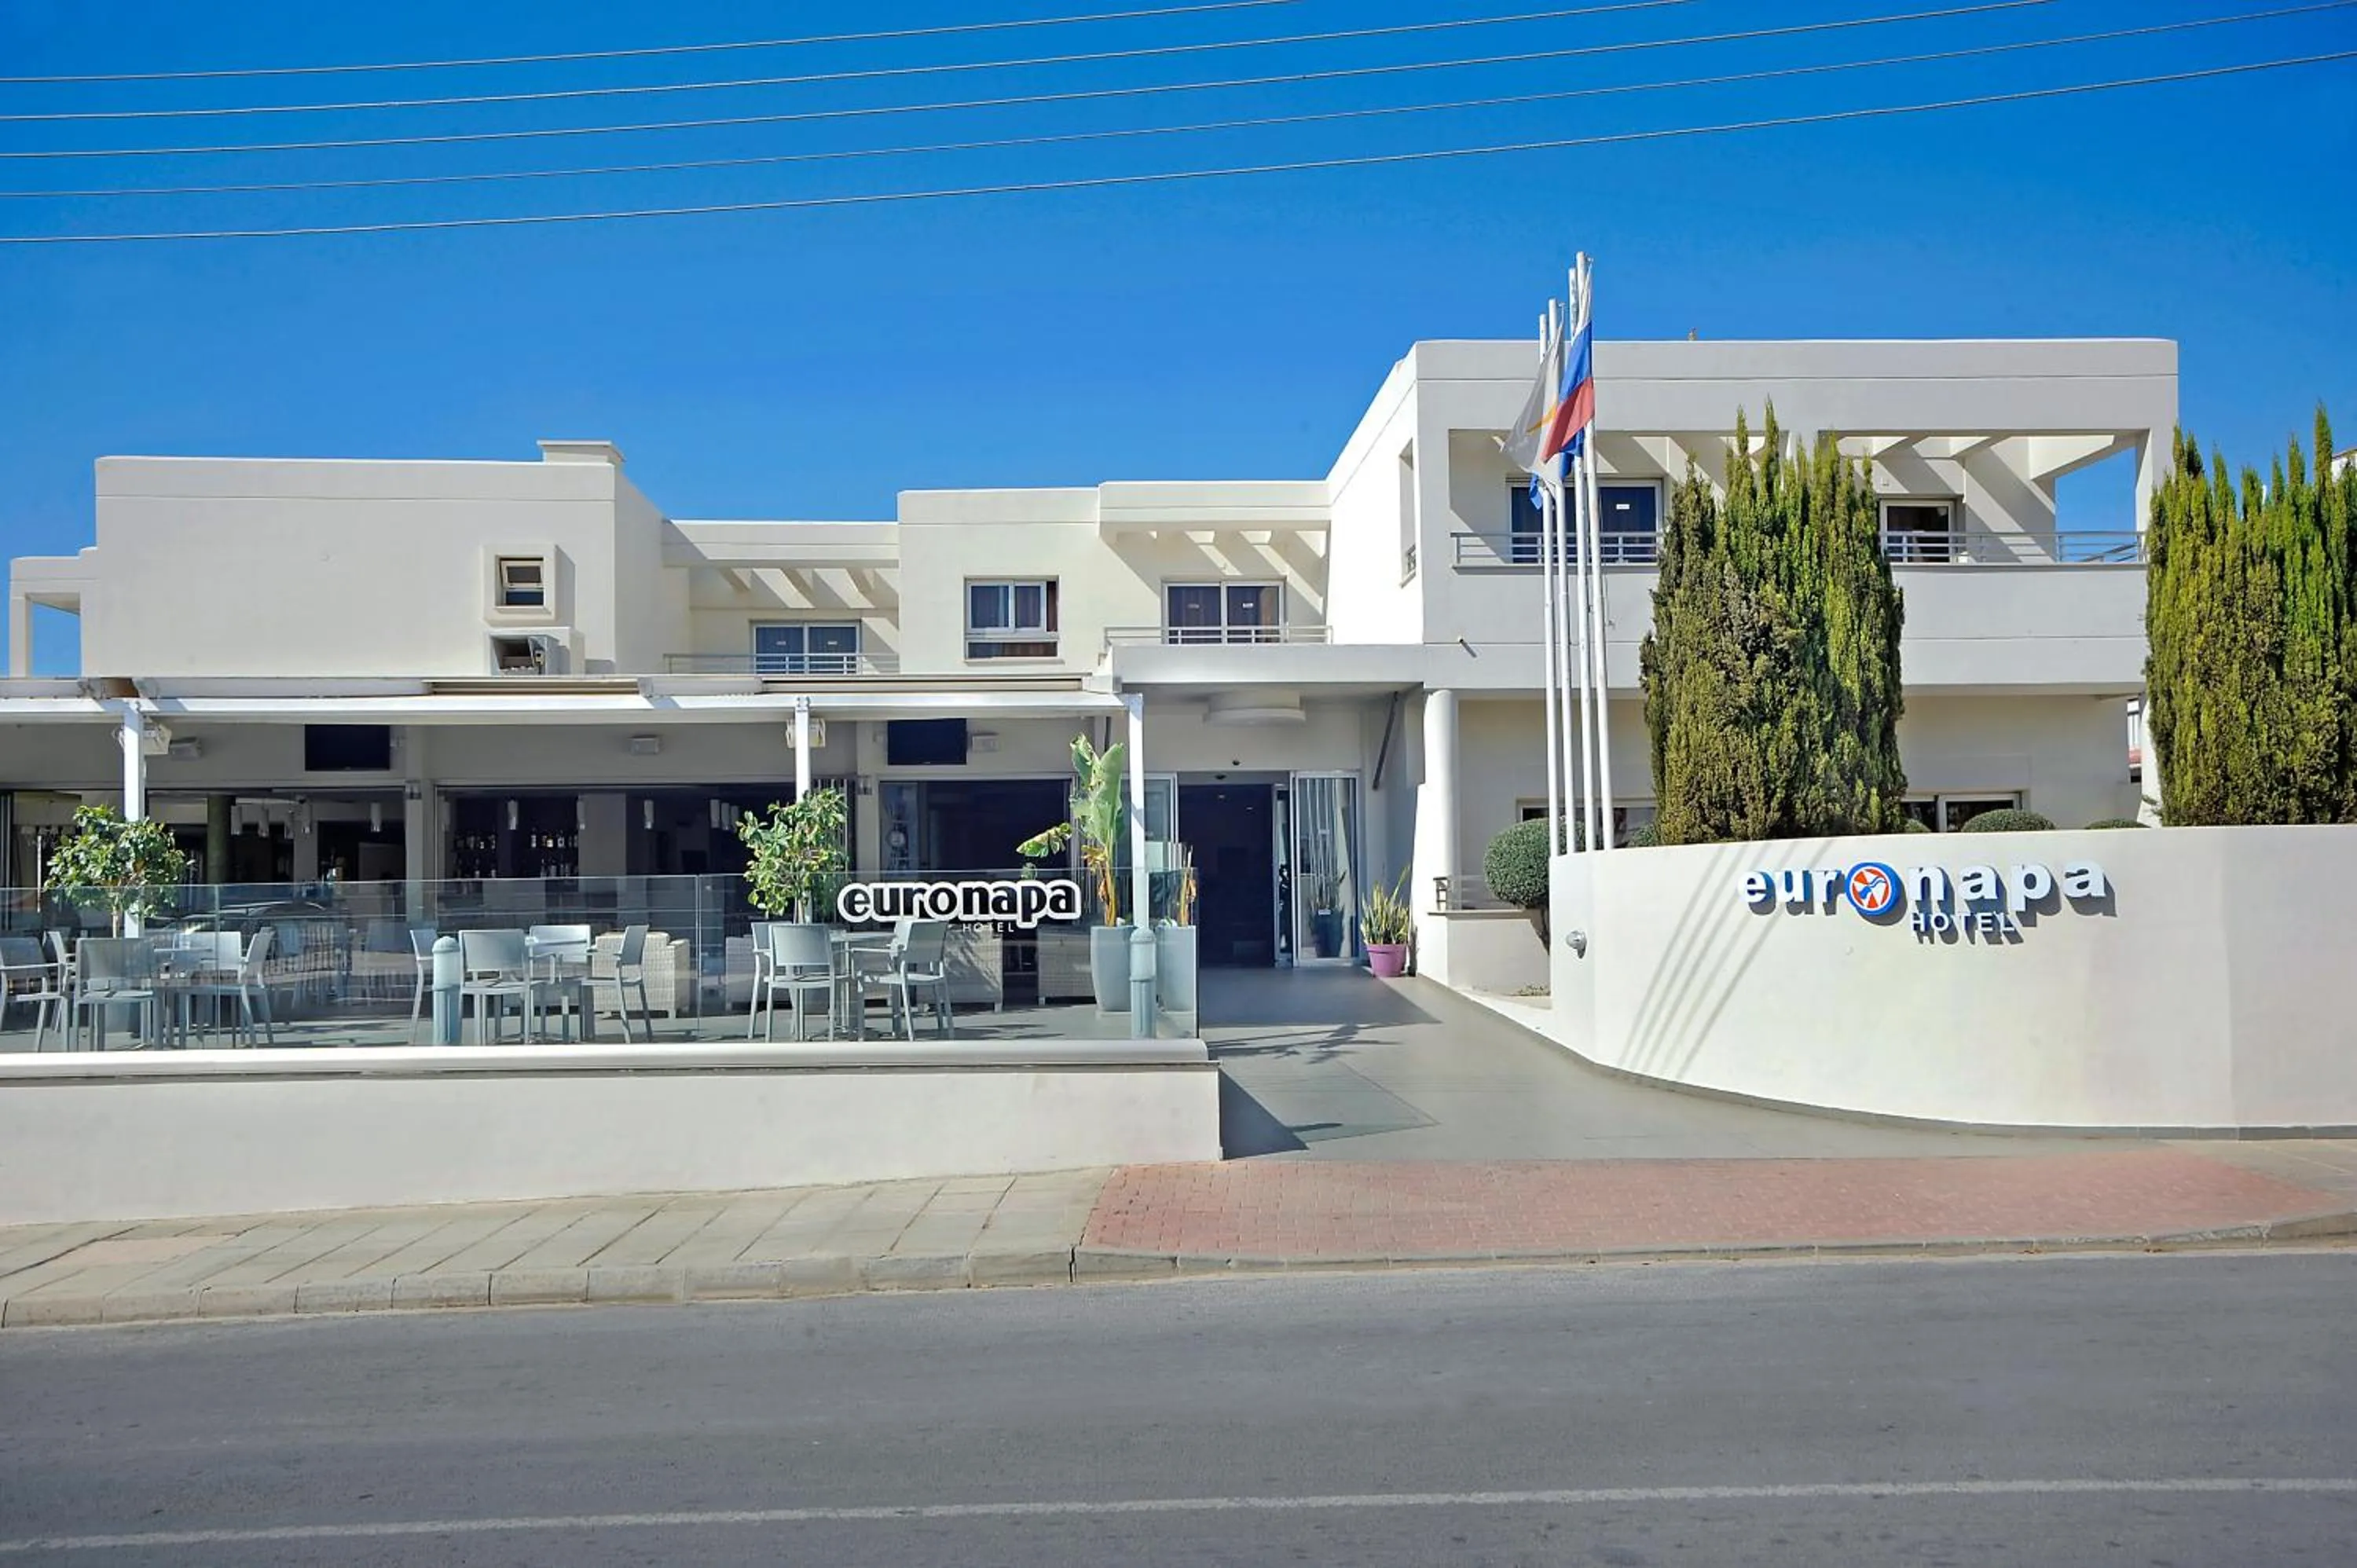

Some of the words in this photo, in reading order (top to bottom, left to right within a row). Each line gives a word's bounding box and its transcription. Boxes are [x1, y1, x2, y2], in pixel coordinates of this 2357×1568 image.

[838, 880, 1081, 928] euronapa
[962, 921, 1015, 933] HOTEL
[1911, 910, 2016, 932] HOTEL
